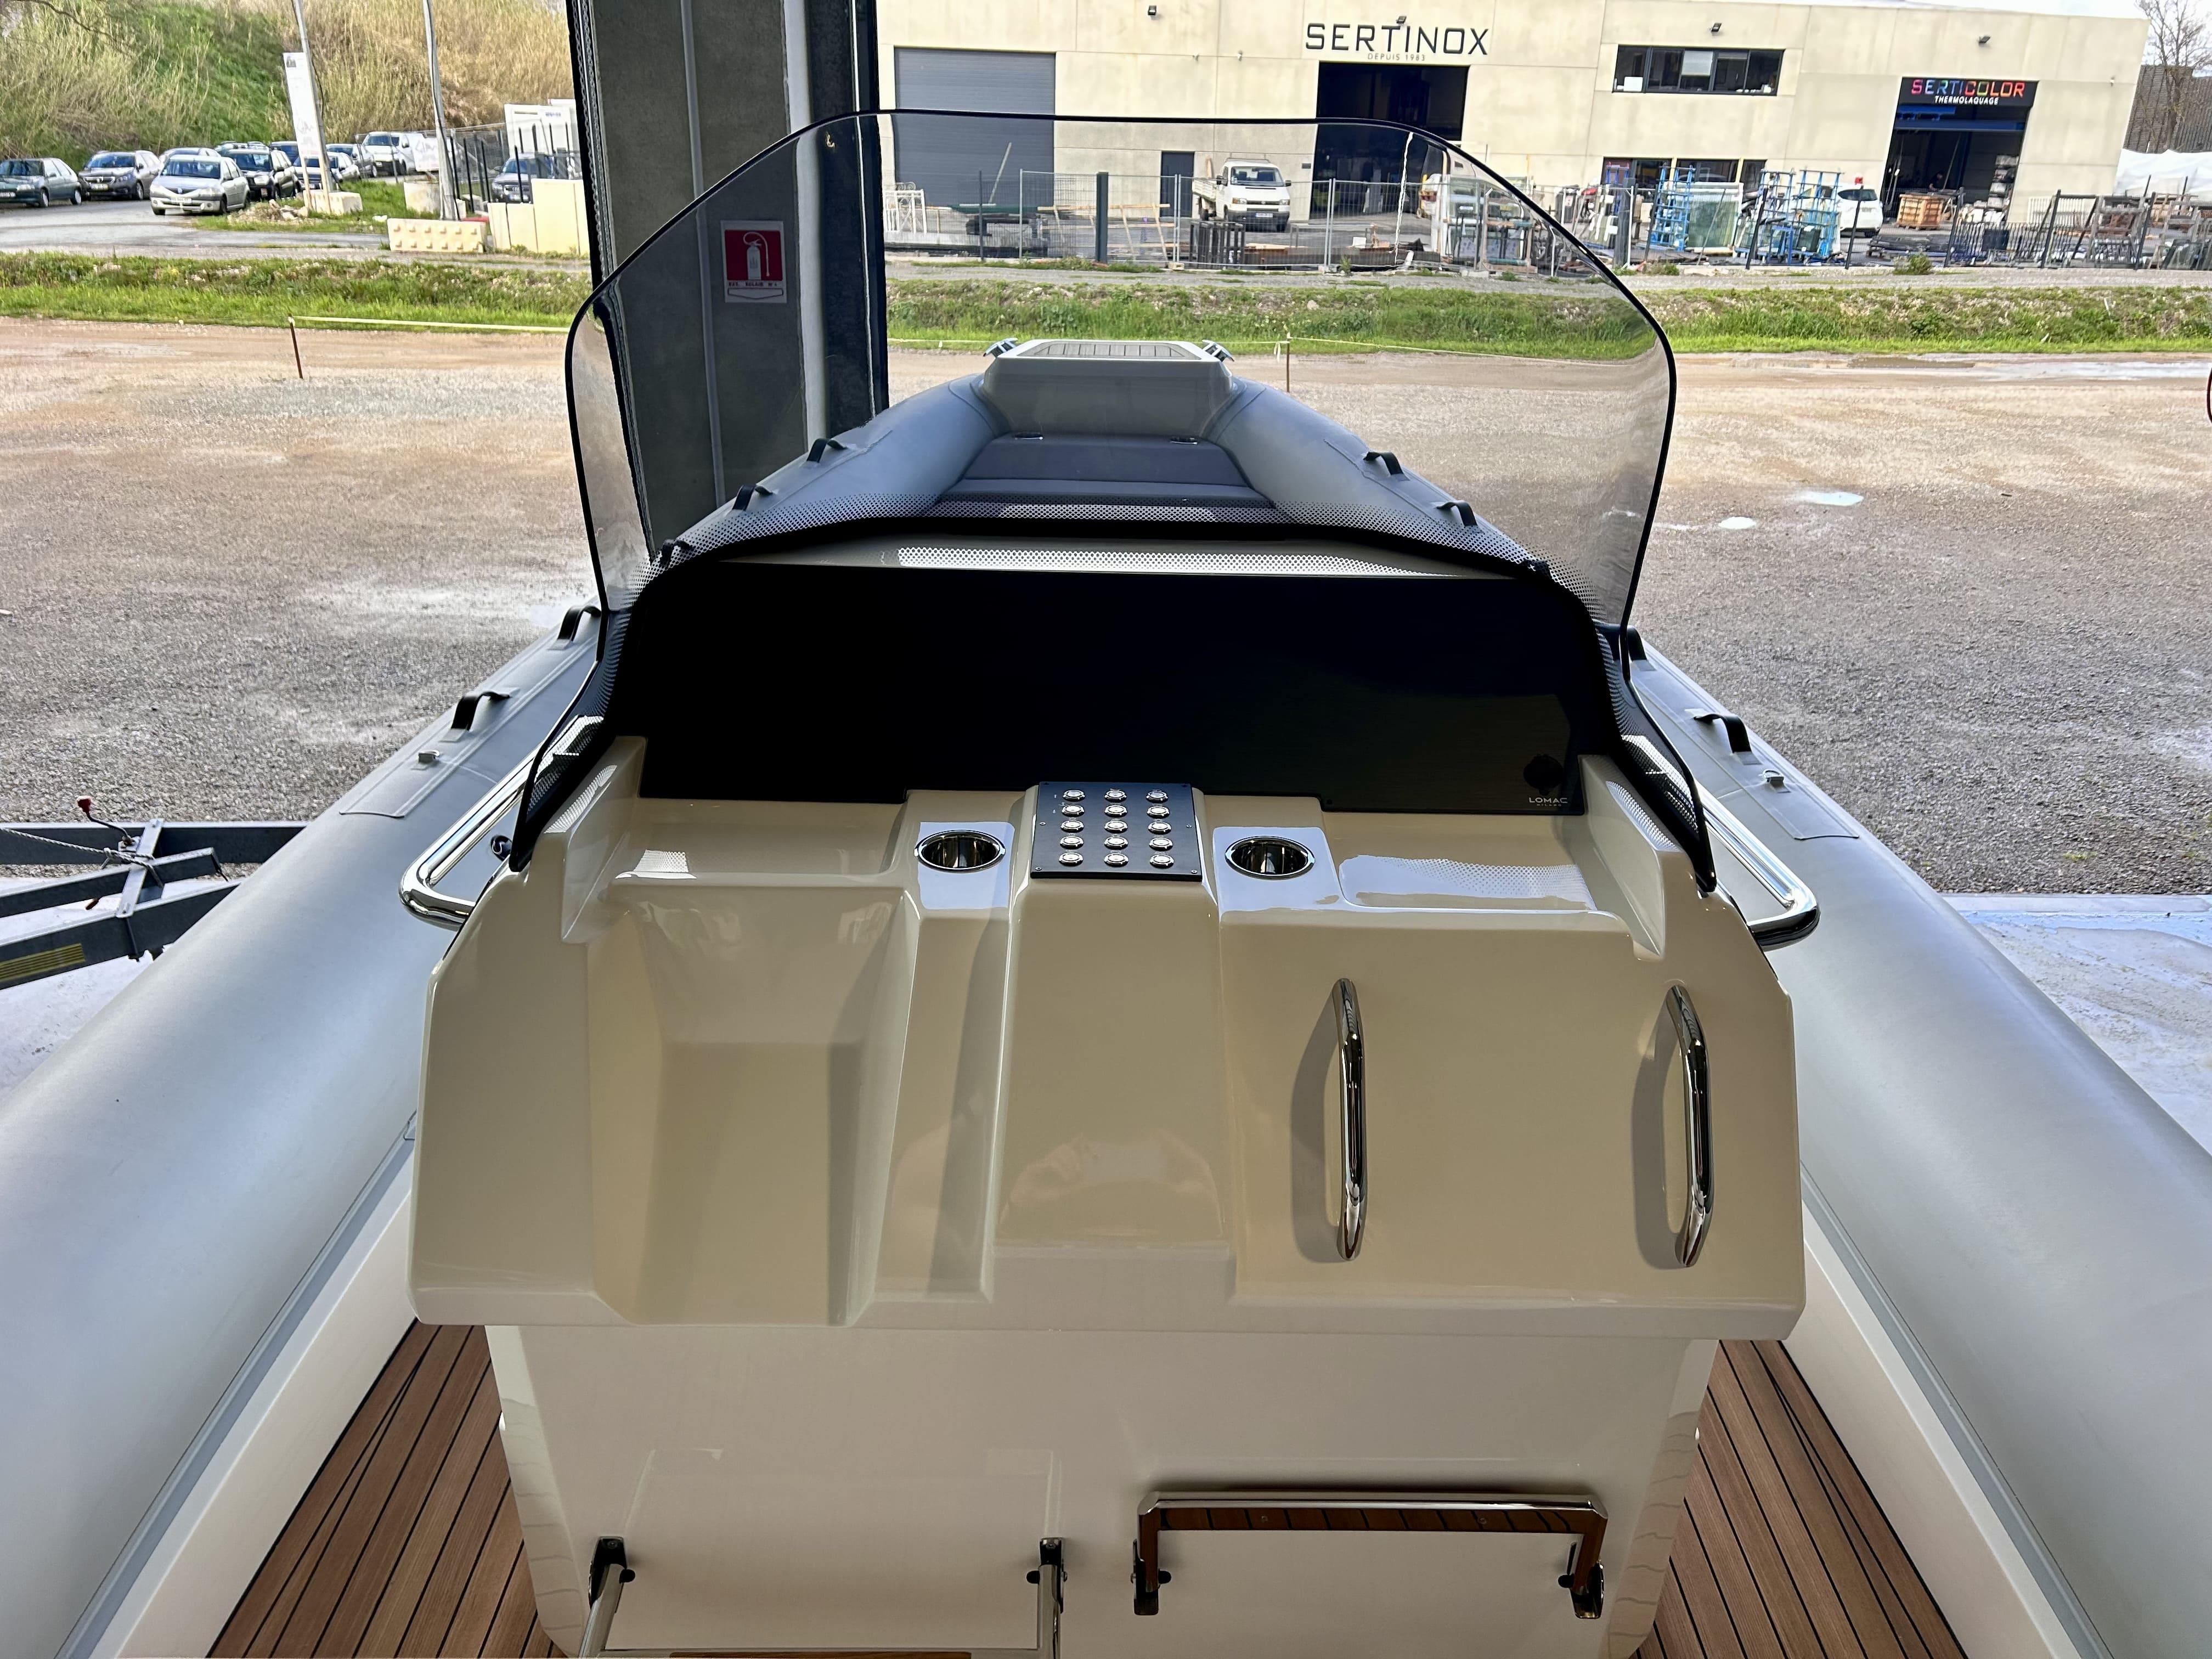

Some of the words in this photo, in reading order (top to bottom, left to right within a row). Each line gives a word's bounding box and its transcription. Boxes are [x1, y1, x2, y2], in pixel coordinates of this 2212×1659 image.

[1306, 22, 1489, 55] SERTINOX
[1368, 53, 1401, 61] DEPUIS
[1911, 79, 2025, 98] SERTICOLOR
[1934, 95, 1999, 105] THERMOLAQUAGE
